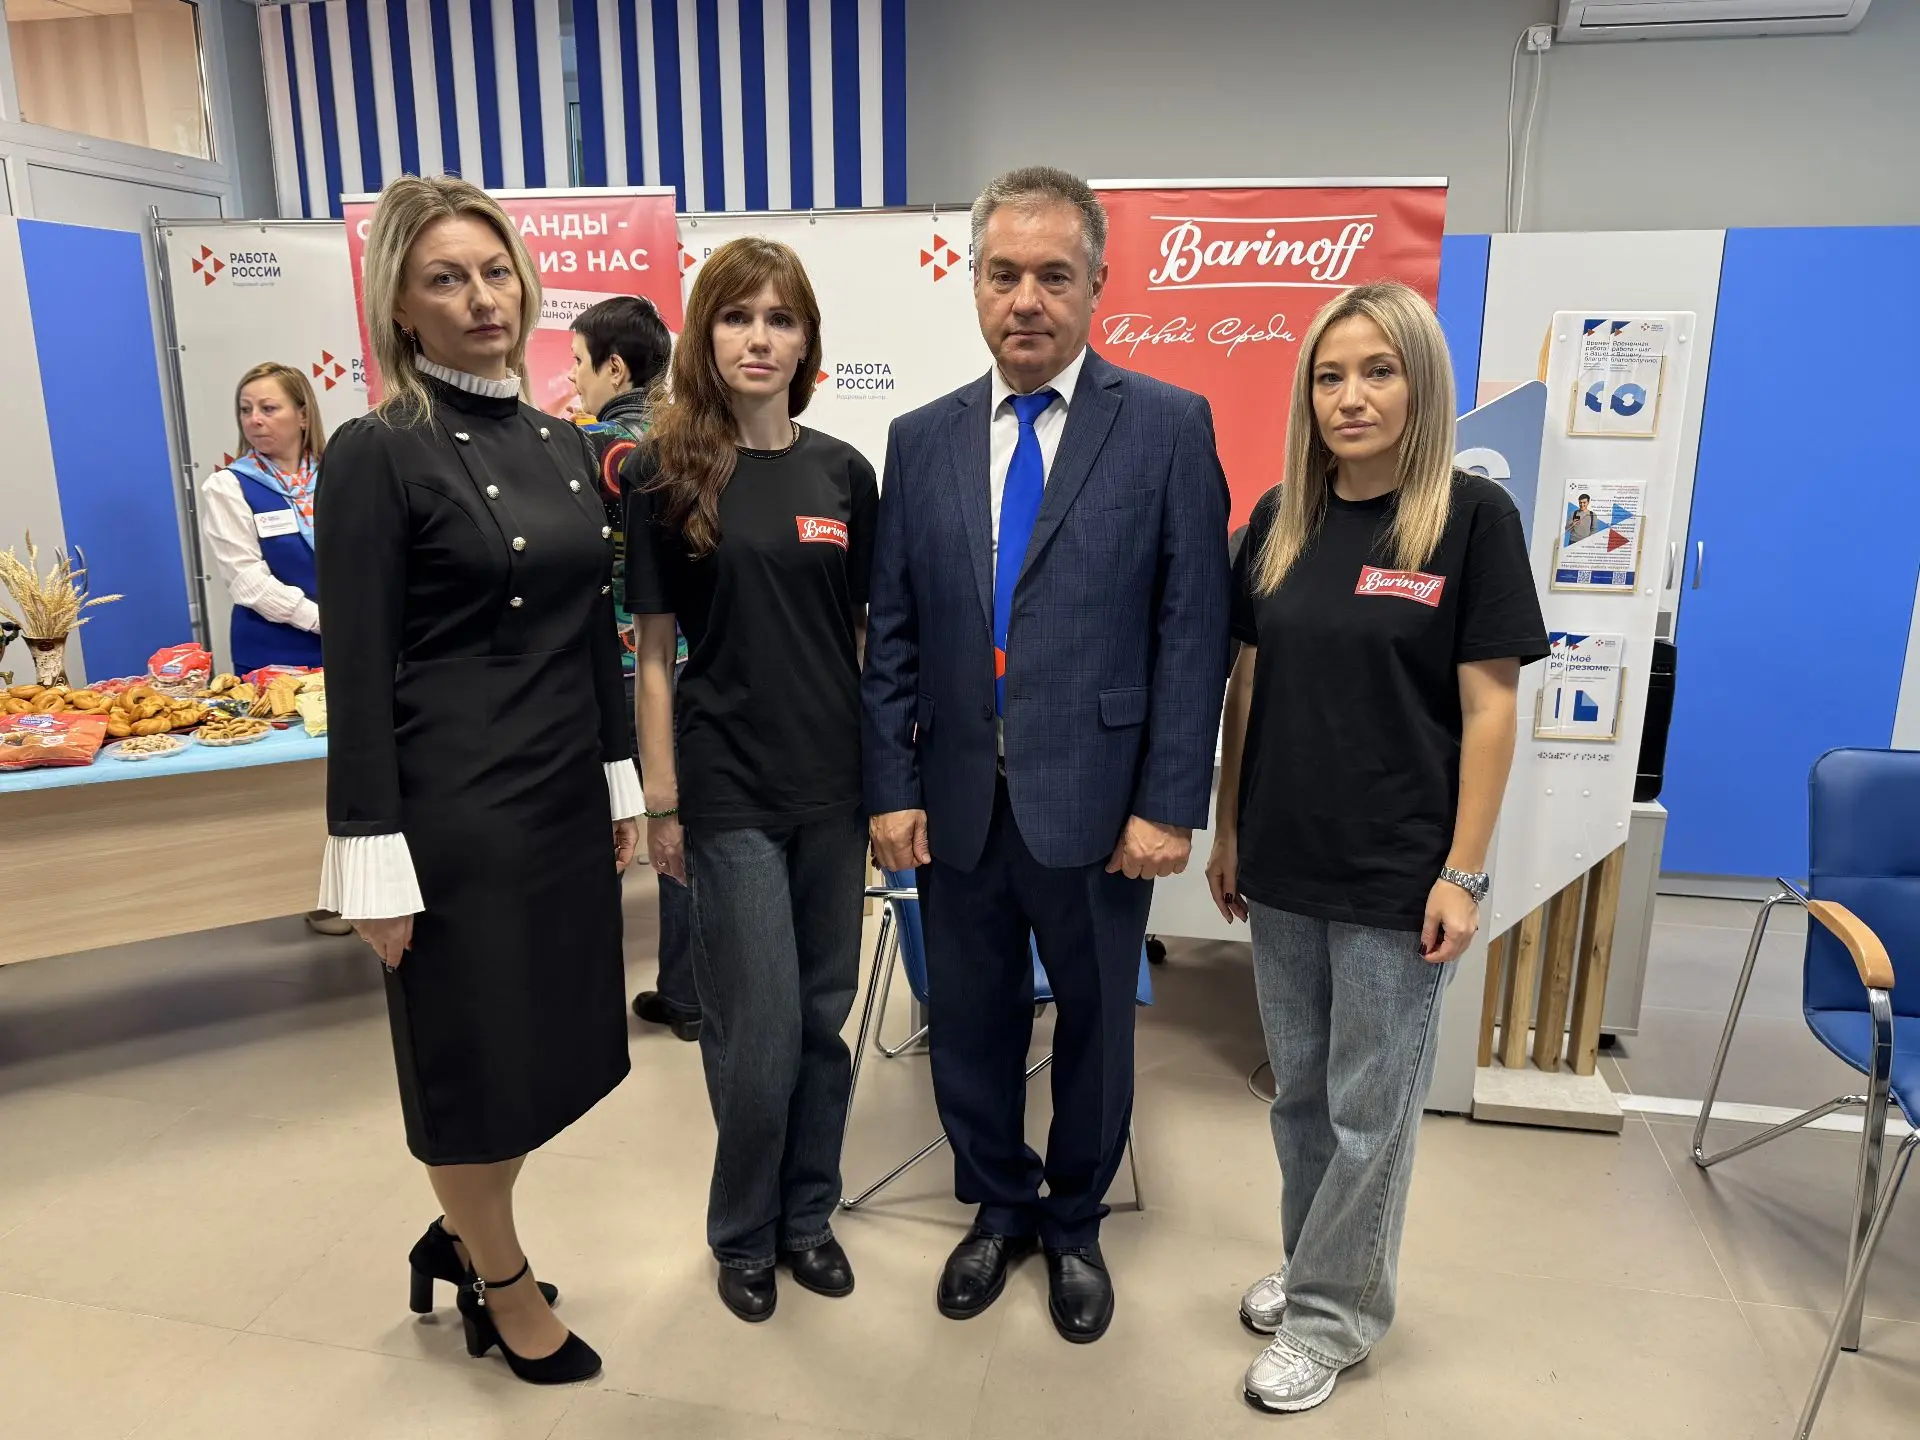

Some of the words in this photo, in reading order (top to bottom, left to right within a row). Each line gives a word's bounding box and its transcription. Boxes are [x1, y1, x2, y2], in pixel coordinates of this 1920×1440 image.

[1149, 219, 1374, 284] Barinoff
[229, 252, 278, 264] РАБОТА
[539, 250, 578, 273] ИЗ
[587, 248, 650, 272] НАС
[231, 266, 281, 278] РОССИИ
[1102, 313, 1197, 358] Первый
[1207, 313, 1296, 358] Среди
[836, 363, 892, 375] РАБОТА
[836, 378, 894, 390] РОССИИ
[1359, 571, 1441, 599] Barinoff
[1570, 654, 1592, 663] Моё
